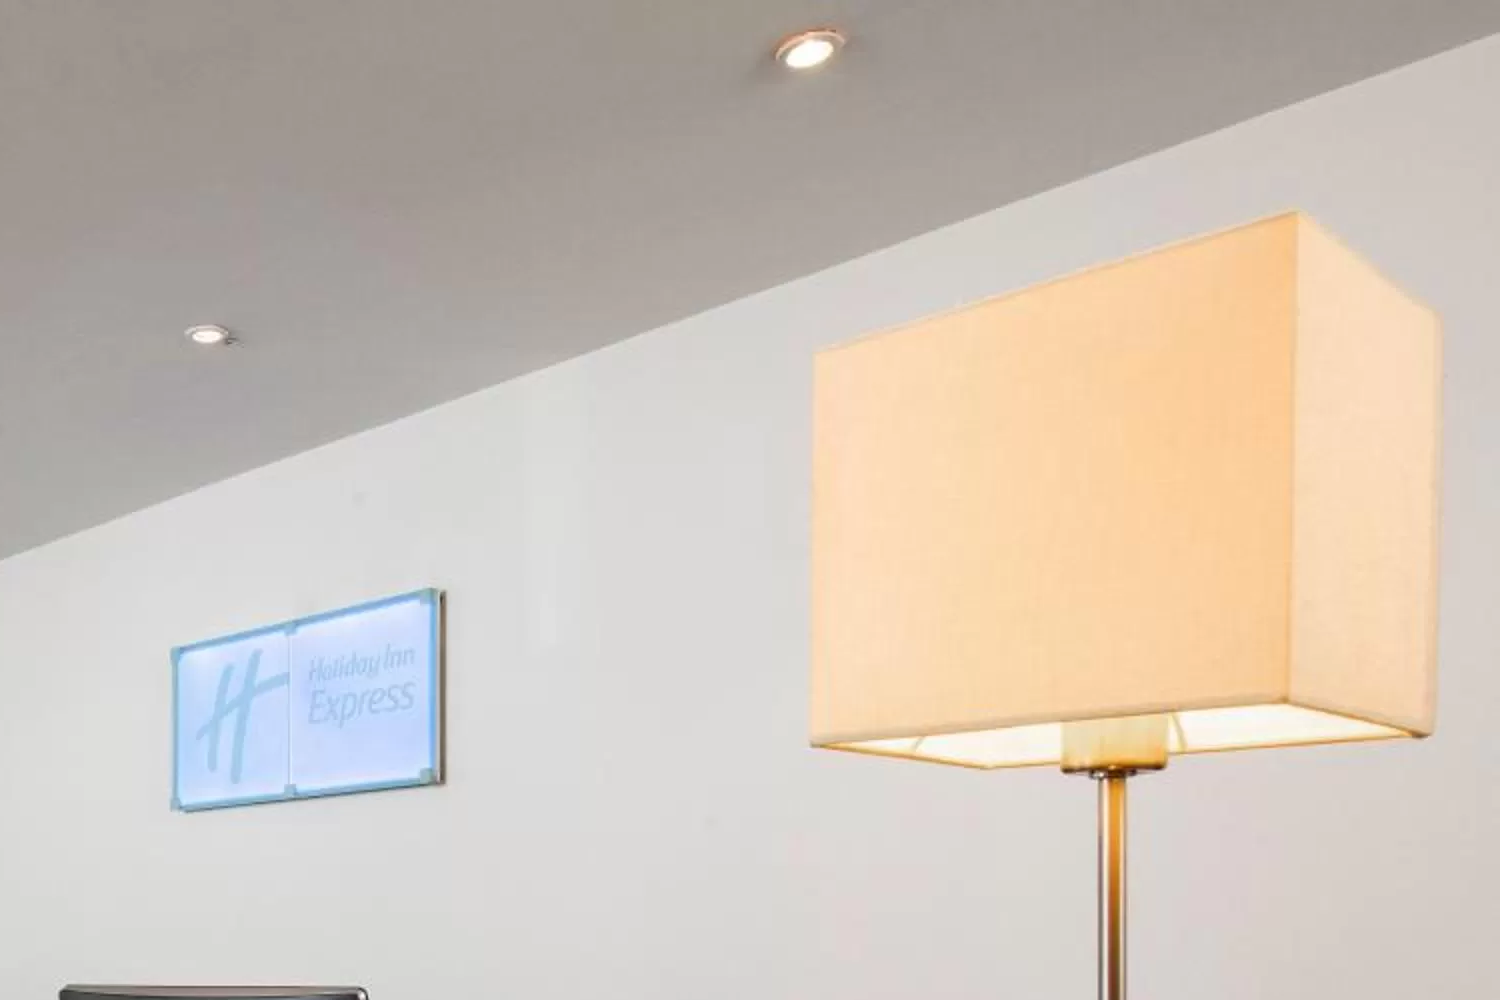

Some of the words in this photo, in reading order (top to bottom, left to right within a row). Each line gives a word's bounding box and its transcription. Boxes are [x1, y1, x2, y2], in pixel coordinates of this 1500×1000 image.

[308, 650, 380, 679] Holiday
[383, 643, 415, 669] Inn
[308, 681, 416, 729] Express
